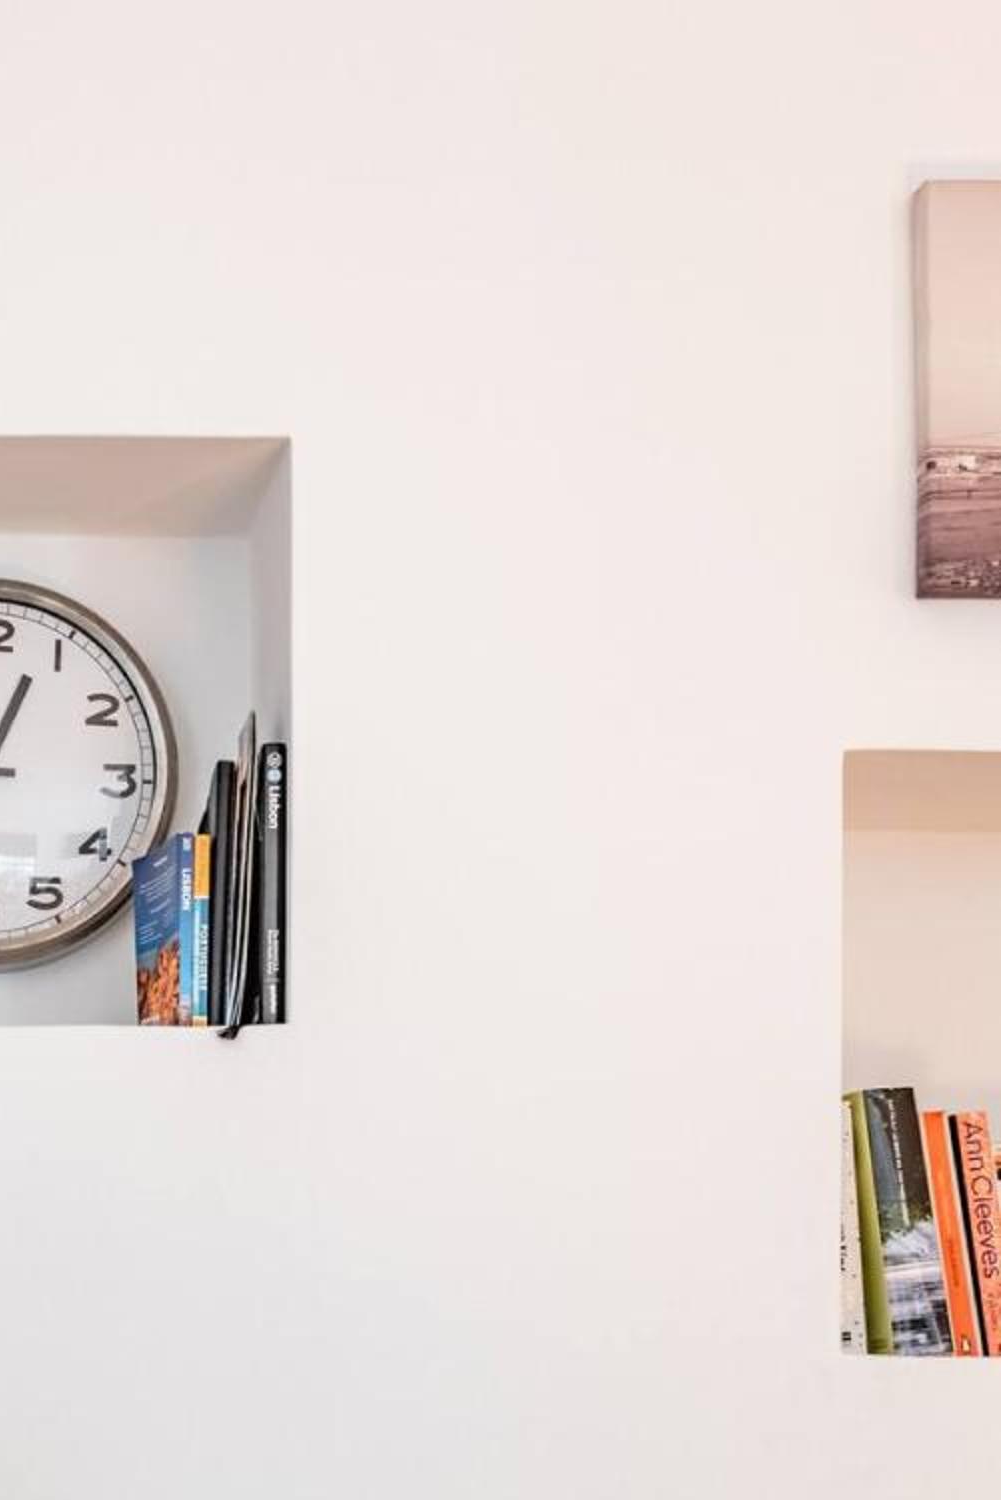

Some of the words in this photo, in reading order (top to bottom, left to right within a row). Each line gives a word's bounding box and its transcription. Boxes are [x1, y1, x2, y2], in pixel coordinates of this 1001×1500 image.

[53, 638, 63, 672] 1
[84, 693, 120, 727] 2
[100, 763, 137, 799] 3
[268, 785, 281, 829] Lisbon
[78, 828, 113, 862] 4
[27, 877, 64, 910] 5
[963, 1122, 985, 1172] Ann
[970, 1175, 1000, 1280] Cleeves
